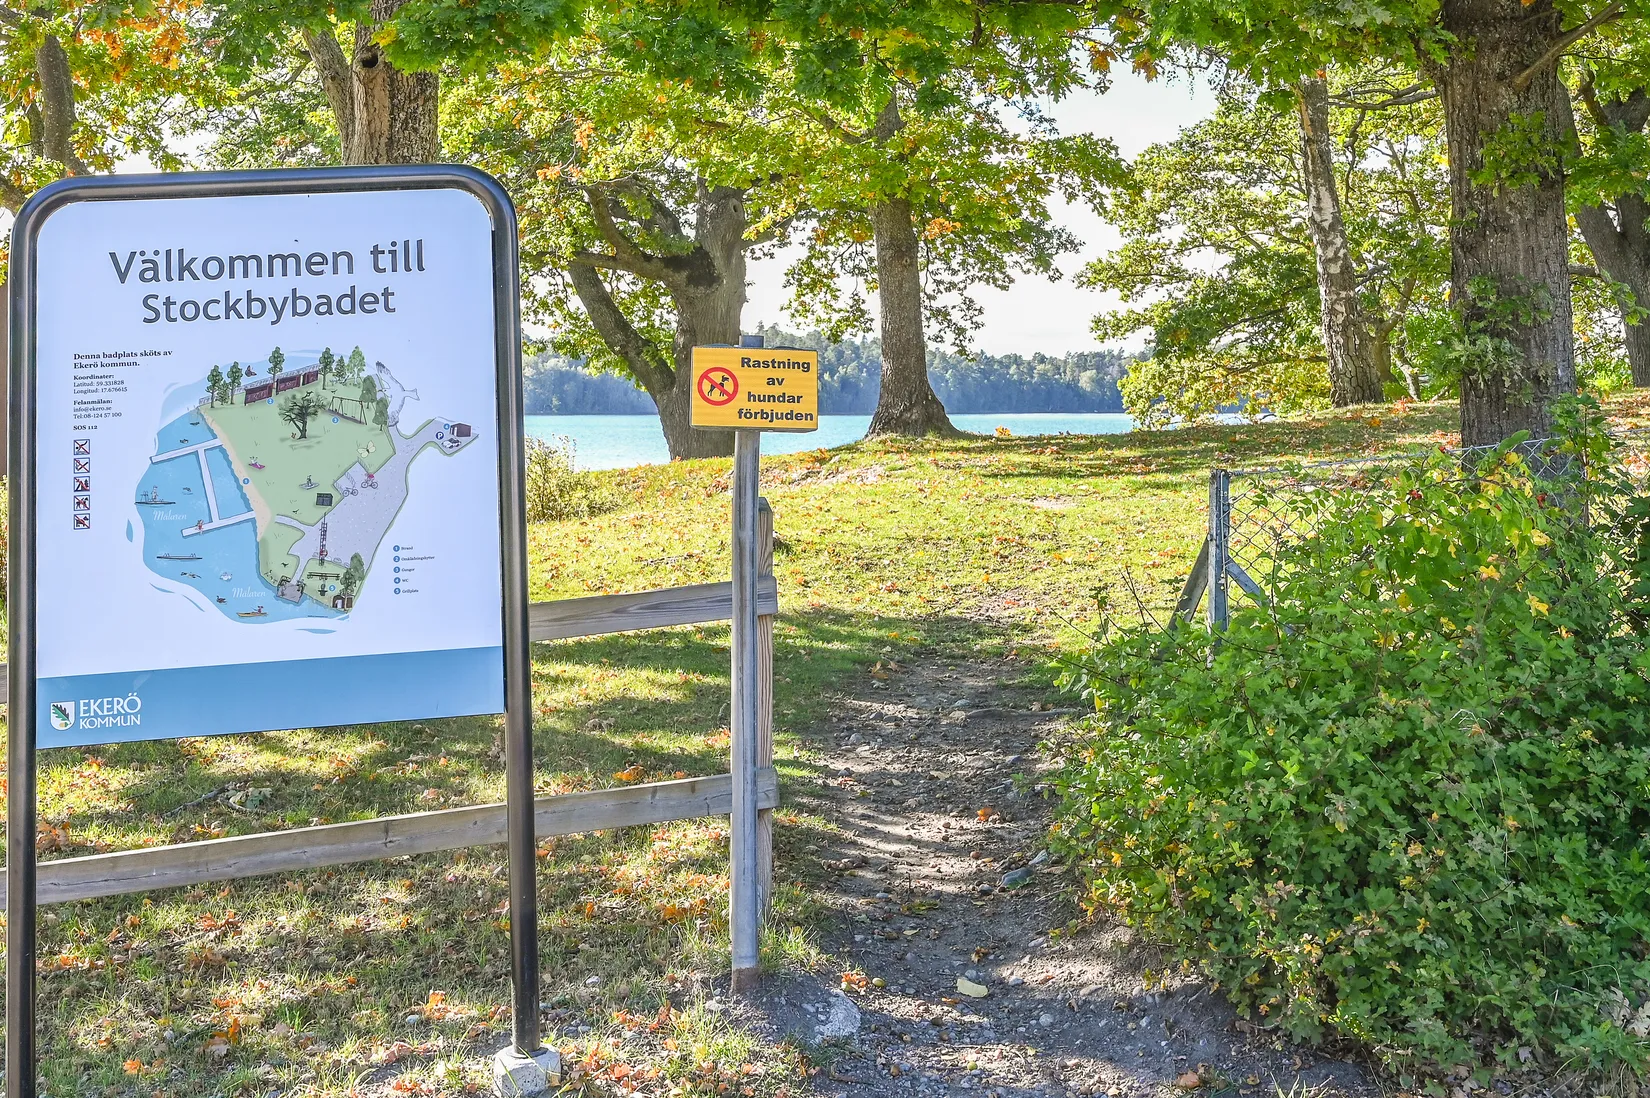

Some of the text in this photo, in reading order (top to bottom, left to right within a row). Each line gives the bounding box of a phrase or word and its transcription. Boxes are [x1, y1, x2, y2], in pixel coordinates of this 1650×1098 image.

[108, 239, 426, 284] Välkommen till
[142, 285, 396, 325] Stockbybadet
[102, 351, 138, 359] badplats
[139, 349, 161, 357] sköts
[100, 360, 140, 368] kommun.
[741, 357, 811, 372] Rastning
[766, 377, 785, 386] av
[747, 391, 803, 404] hundar
[737, 408, 814, 423] förbjuden
[79, 692, 142, 717] EKERÖ
[79, 714, 141, 730] KOMMUN
